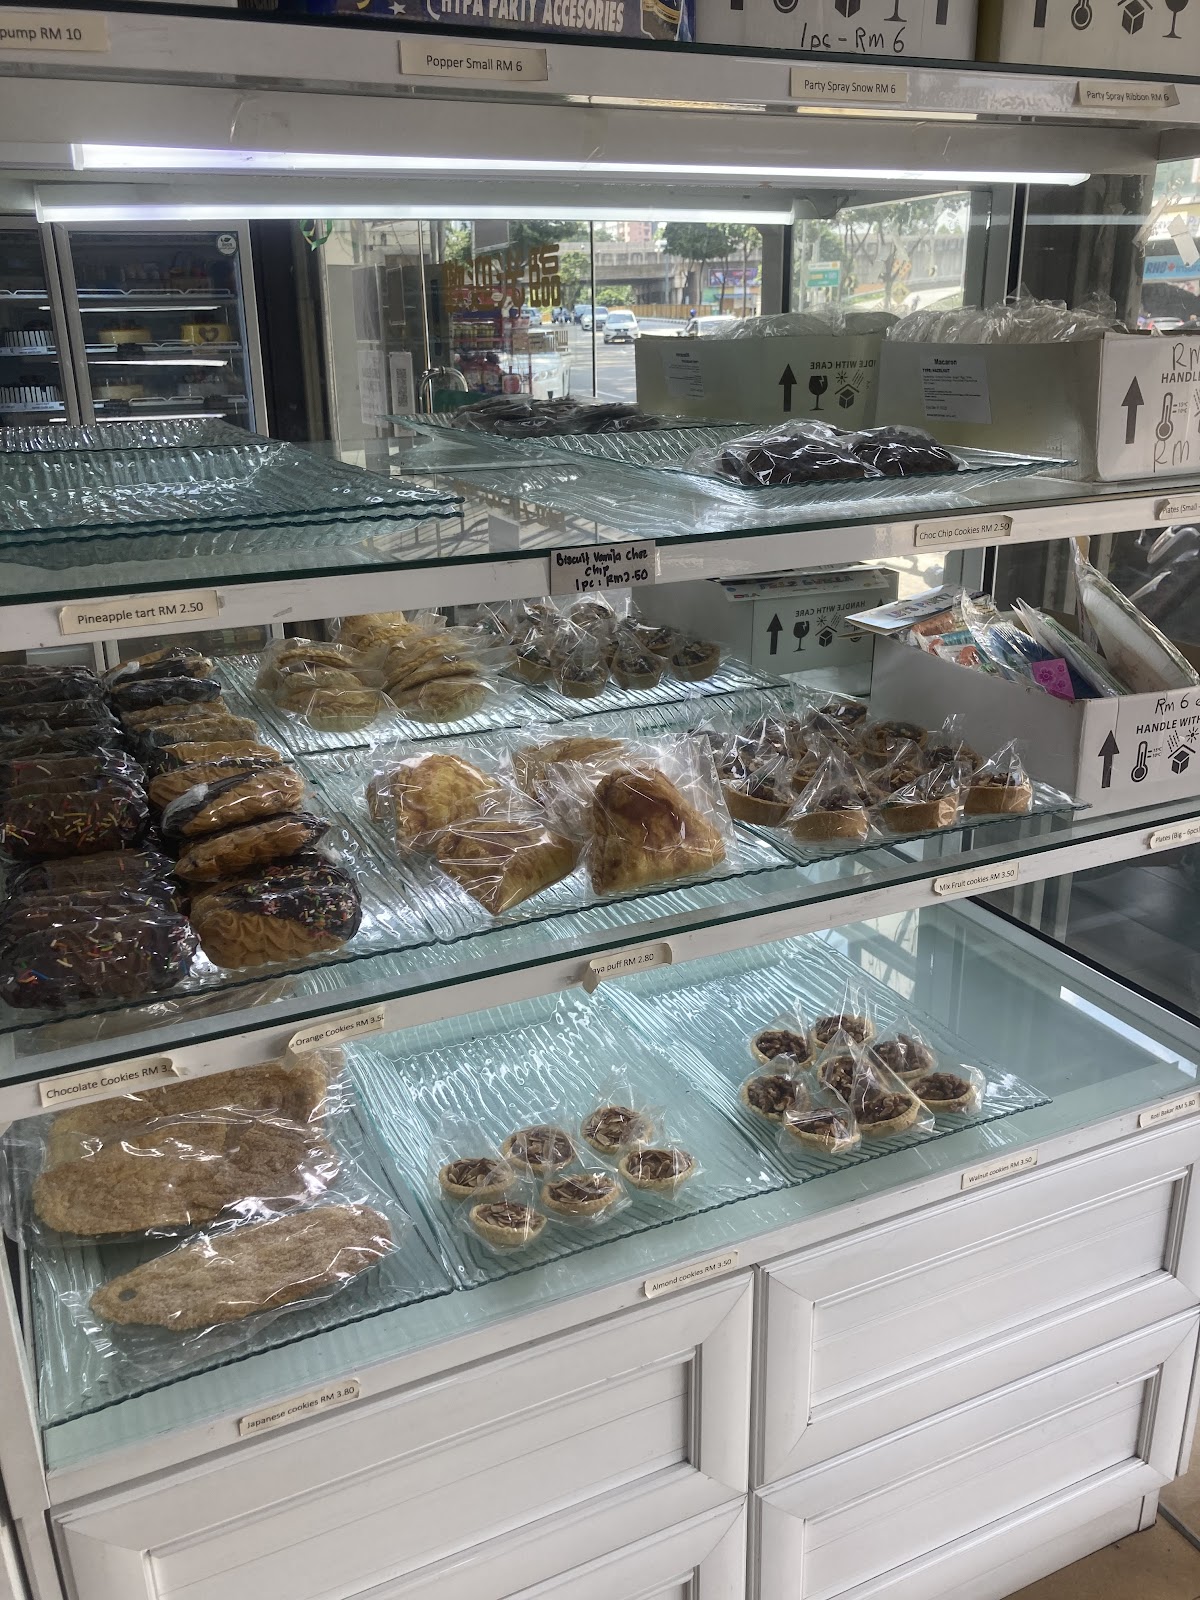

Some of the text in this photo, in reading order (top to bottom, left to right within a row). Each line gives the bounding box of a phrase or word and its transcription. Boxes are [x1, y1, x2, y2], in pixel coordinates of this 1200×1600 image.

[489, 0, 536, 22] PARTY
[542, 0, 624, 32] ACCESORIES
[0, 27, 82, 42] pump RM 10
[893, 26, 905, 53] 6
[427, 55, 523, 71] Popper Small RM 6
[804, 80, 896, 94] Party Spray Snow RM 6
[1087, 91, 1105, 101] Party
[1106, 92, 1124, 102] Spray
[1126, 93, 1149, 101] Ribbon
[1151, 93, 1162, 101] RM
[1161, 371, 1200, 384] HANDL
[920, 522, 1010, 540] Choc Chip Cookies RM 2.50
[77, 602, 204, 625] Pineapple tart RM 2.50
[1180, 692, 1190, 709] 6
[1136, 719, 1177, 735] HANDLE
[939, 869, 1015, 892] Mix Fruit cookies RM 3.50
[592, 953, 655, 974] aya puff RM 2.80
[295, 1033, 324, 1046] Orange
[325, 1023, 354, 1037] Cookies
[355, 1018, 369, 1028] RM
[46, 1081, 98, 1099] Chocolate
[100, 1072, 140, 1087] Cookies
[142, 1066, 159, 1077] RM
[1150, 1099, 1196, 1120] Roti Bakar RM 5.80
[968, 1156, 1033, 1183] Walnut cookies RM 3.50
[652, 1258, 732, 1291] Almond cookies RM 3.50
[247, 1386, 355, 1429] Japanese cookies RM 3.80
